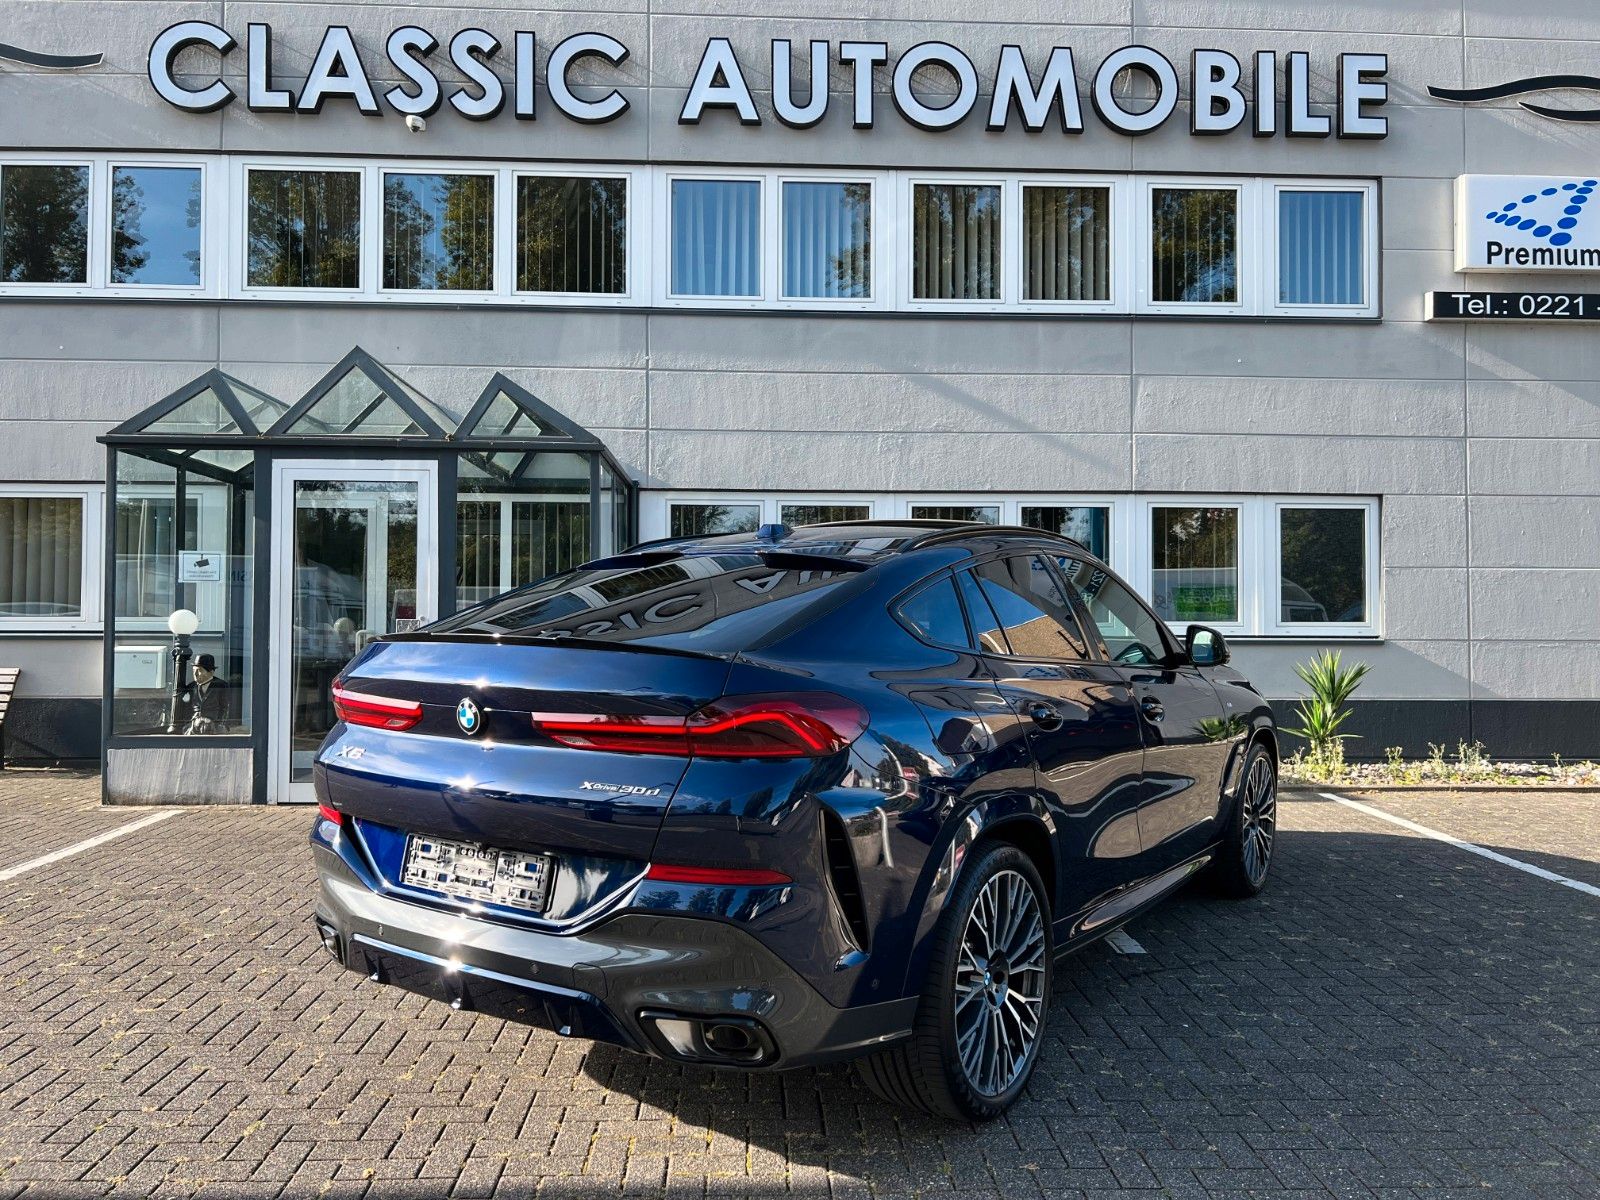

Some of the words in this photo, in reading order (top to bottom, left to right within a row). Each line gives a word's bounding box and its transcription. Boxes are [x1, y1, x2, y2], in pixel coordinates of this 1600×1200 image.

[148, 20, 631, 124] CLASSIC
[678, 37, 1388, 140] AUTOMOBILE
[1486, 241, 1600, 266] Premium
[1452, 294, 1508, 315] Tel.:
[1519, 295, 1584, 316] 0221
